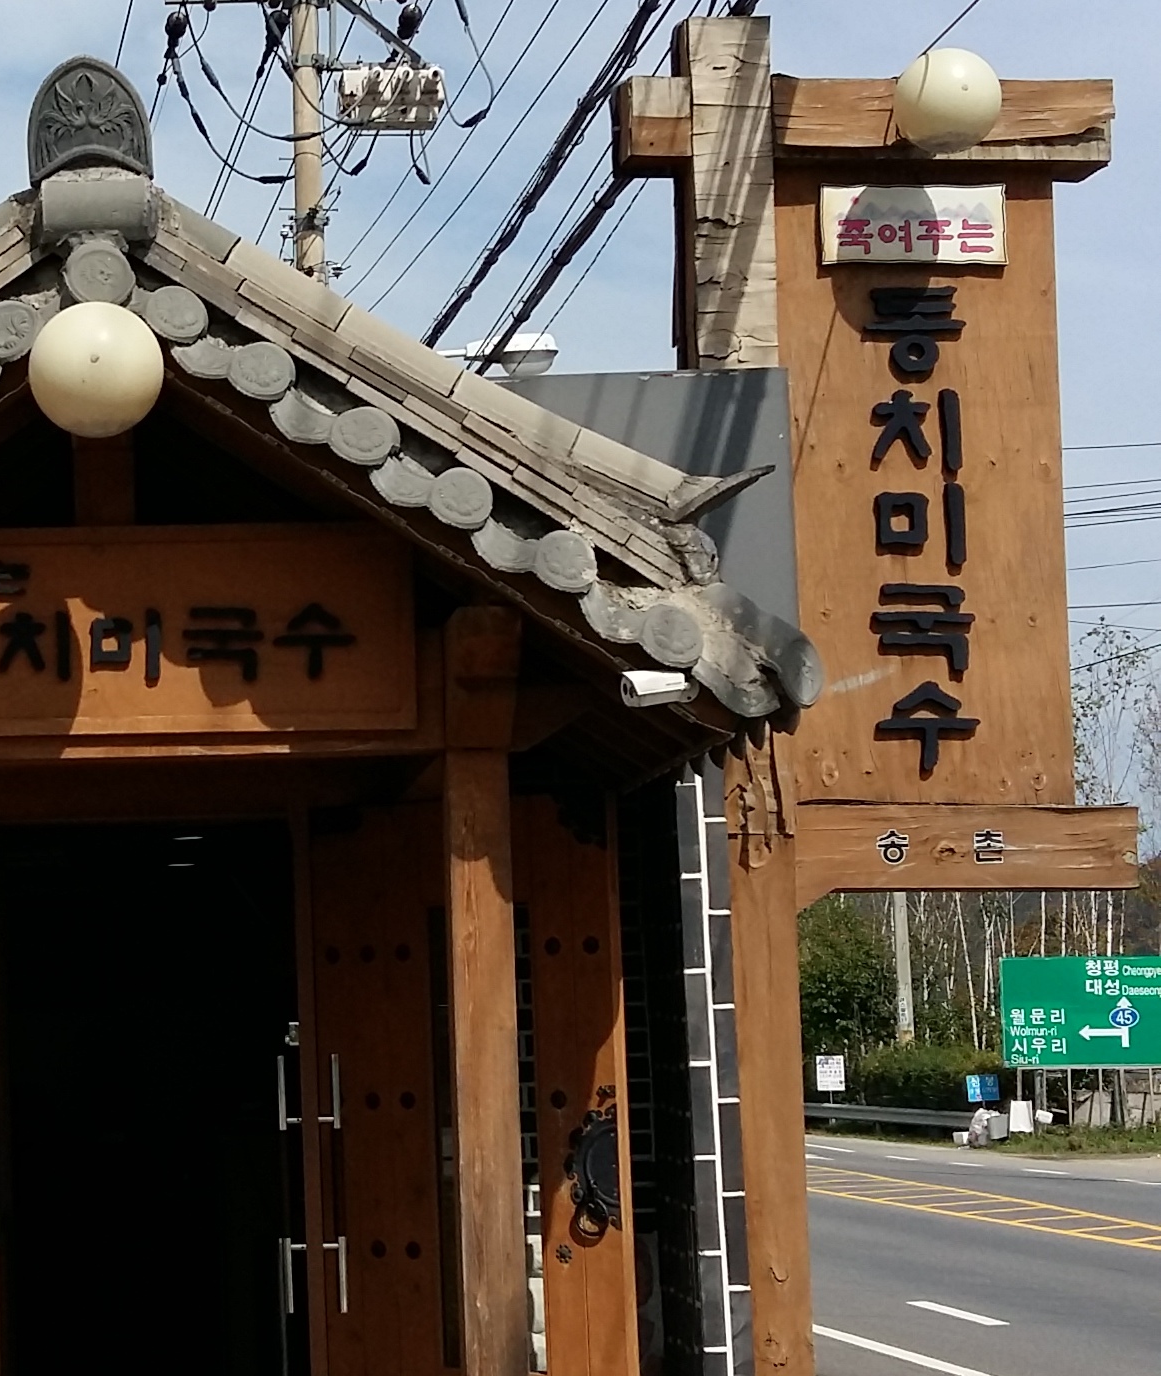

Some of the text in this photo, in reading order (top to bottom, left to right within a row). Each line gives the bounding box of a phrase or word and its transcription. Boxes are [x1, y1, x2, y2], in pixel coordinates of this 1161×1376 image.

[836, 219, 995, 256] 죽여주는
[862, 285, 980, 774] 동치미국수
[1085, 959, 1120, 976] 청평
[1085, 979, 1120, 996] 대성
[1009, 1008, 1065, 1025] 월문리
[1116, 1010, 1133, 1025] 45
[1010, 1025, 1057, 1036] Wolmun-ri
[1011, 1037, 1067, 1055] 시우리
[1011, 1054, 1039, 1064] Siu-ri
